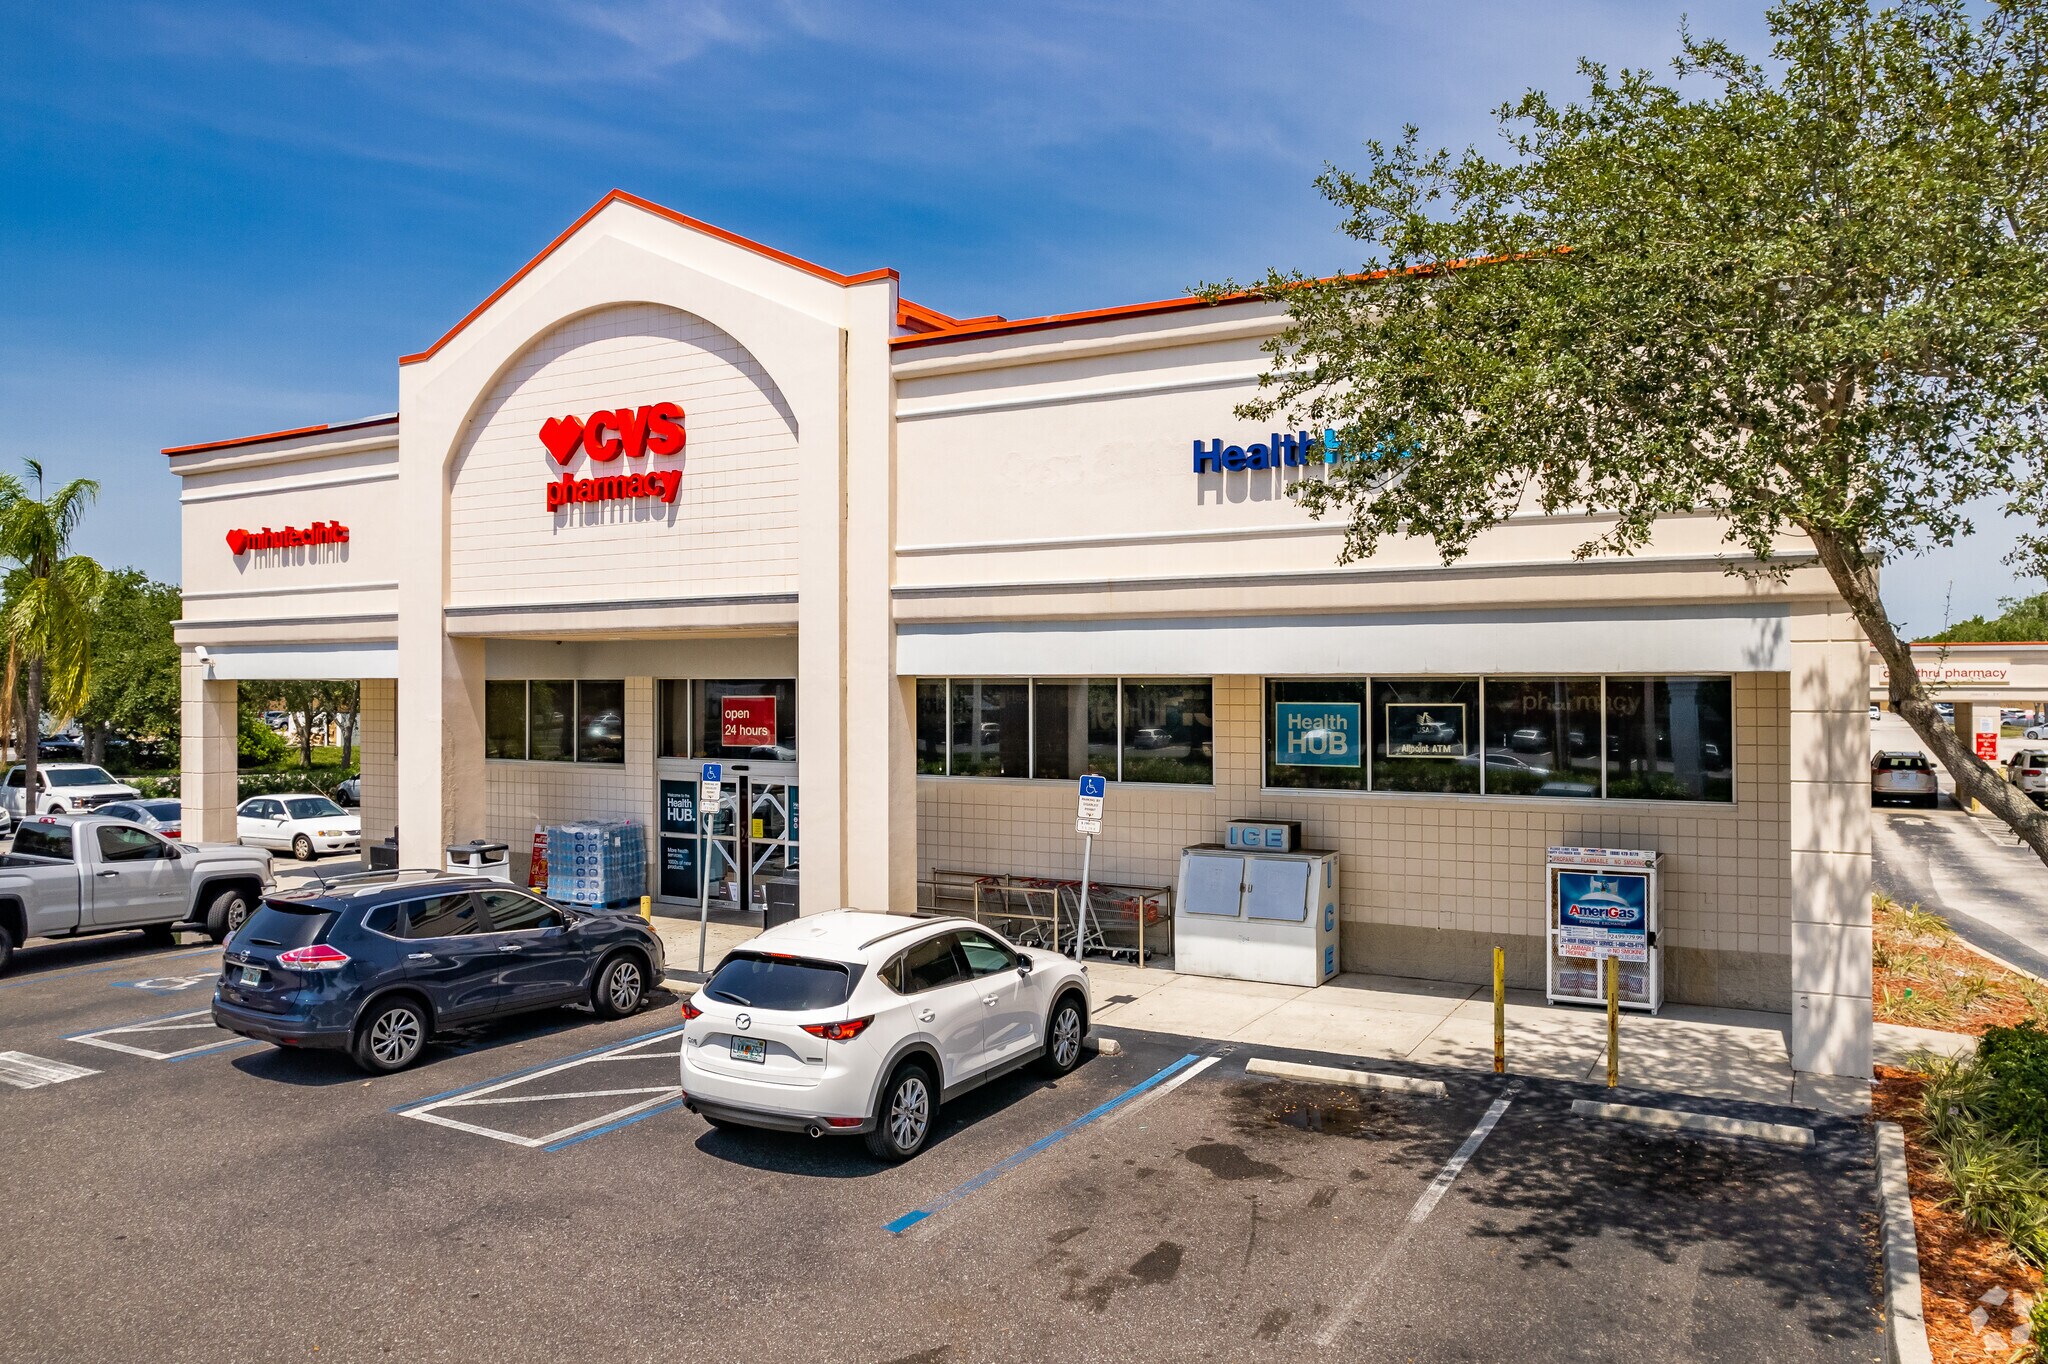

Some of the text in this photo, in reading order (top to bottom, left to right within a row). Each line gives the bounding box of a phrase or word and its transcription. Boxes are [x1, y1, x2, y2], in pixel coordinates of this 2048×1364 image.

[583, 402, 686, 462] CVS
[547, 470, 682, 513] pharmacy
[1945, 668, 2007, 679] pharmacy
[725, 710, 750, 721] open
[1288, 713, 1348, 730] Health
[725, 724, 768, 736] 24 hours
[1288, 731, 1348, 755] HUB
[1432, 744, 1451, 753] ATM
[667, 797, 692, 808] Health
[667, 807, 696, 821] HUB.
[1230, 826, 1283, 847] ICE
[1324, 860, 1335, 976] ICE
[1569, 904, 1635, 918] AmeriGas
[1566, 944, 1595, 952] FLAMMABLE
[1621, 948, 1645, 956] SMOKING
